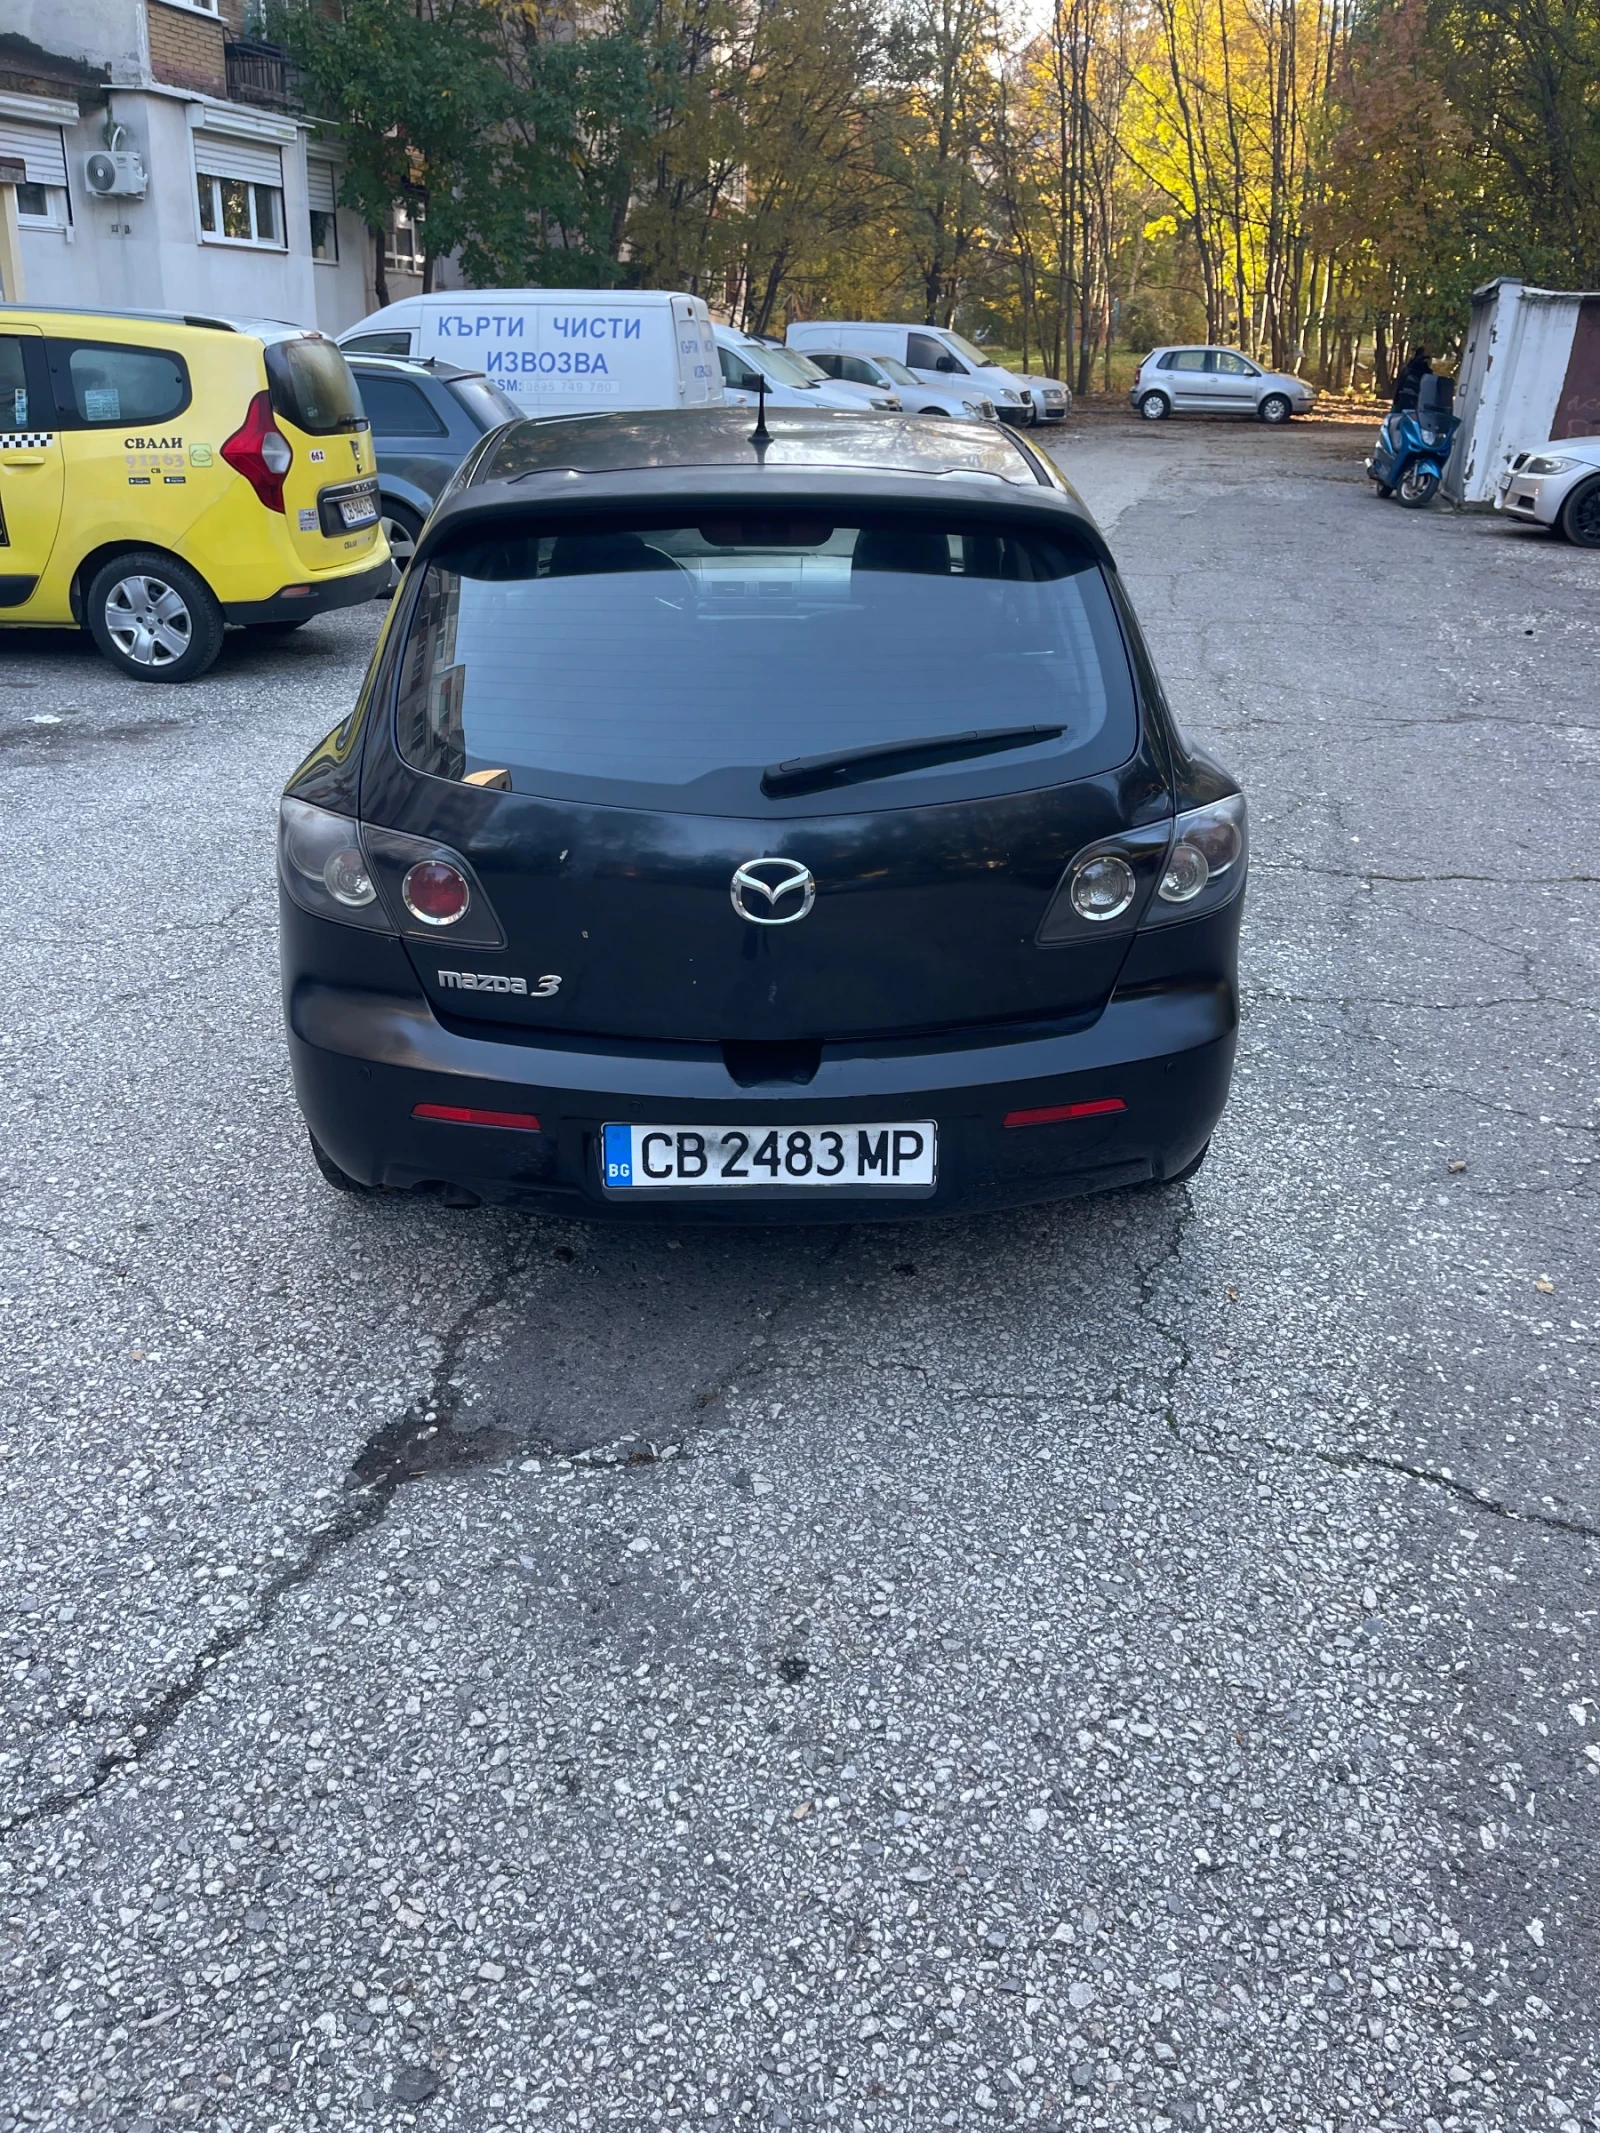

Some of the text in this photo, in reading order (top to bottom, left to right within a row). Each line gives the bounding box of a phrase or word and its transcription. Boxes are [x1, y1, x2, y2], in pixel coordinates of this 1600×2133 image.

[438, 316, 641, 339] КЪРТИ ЧИСТИ
[487, 351, 609, 375] ИЗВОЗВА
[561, 382, 584, 392] 749
[124, 437, 183, 449] СВАЛИ
[530, 975, 563, 997] 3
[608, 1130, 924, 1179] BG CB 2483 MP
